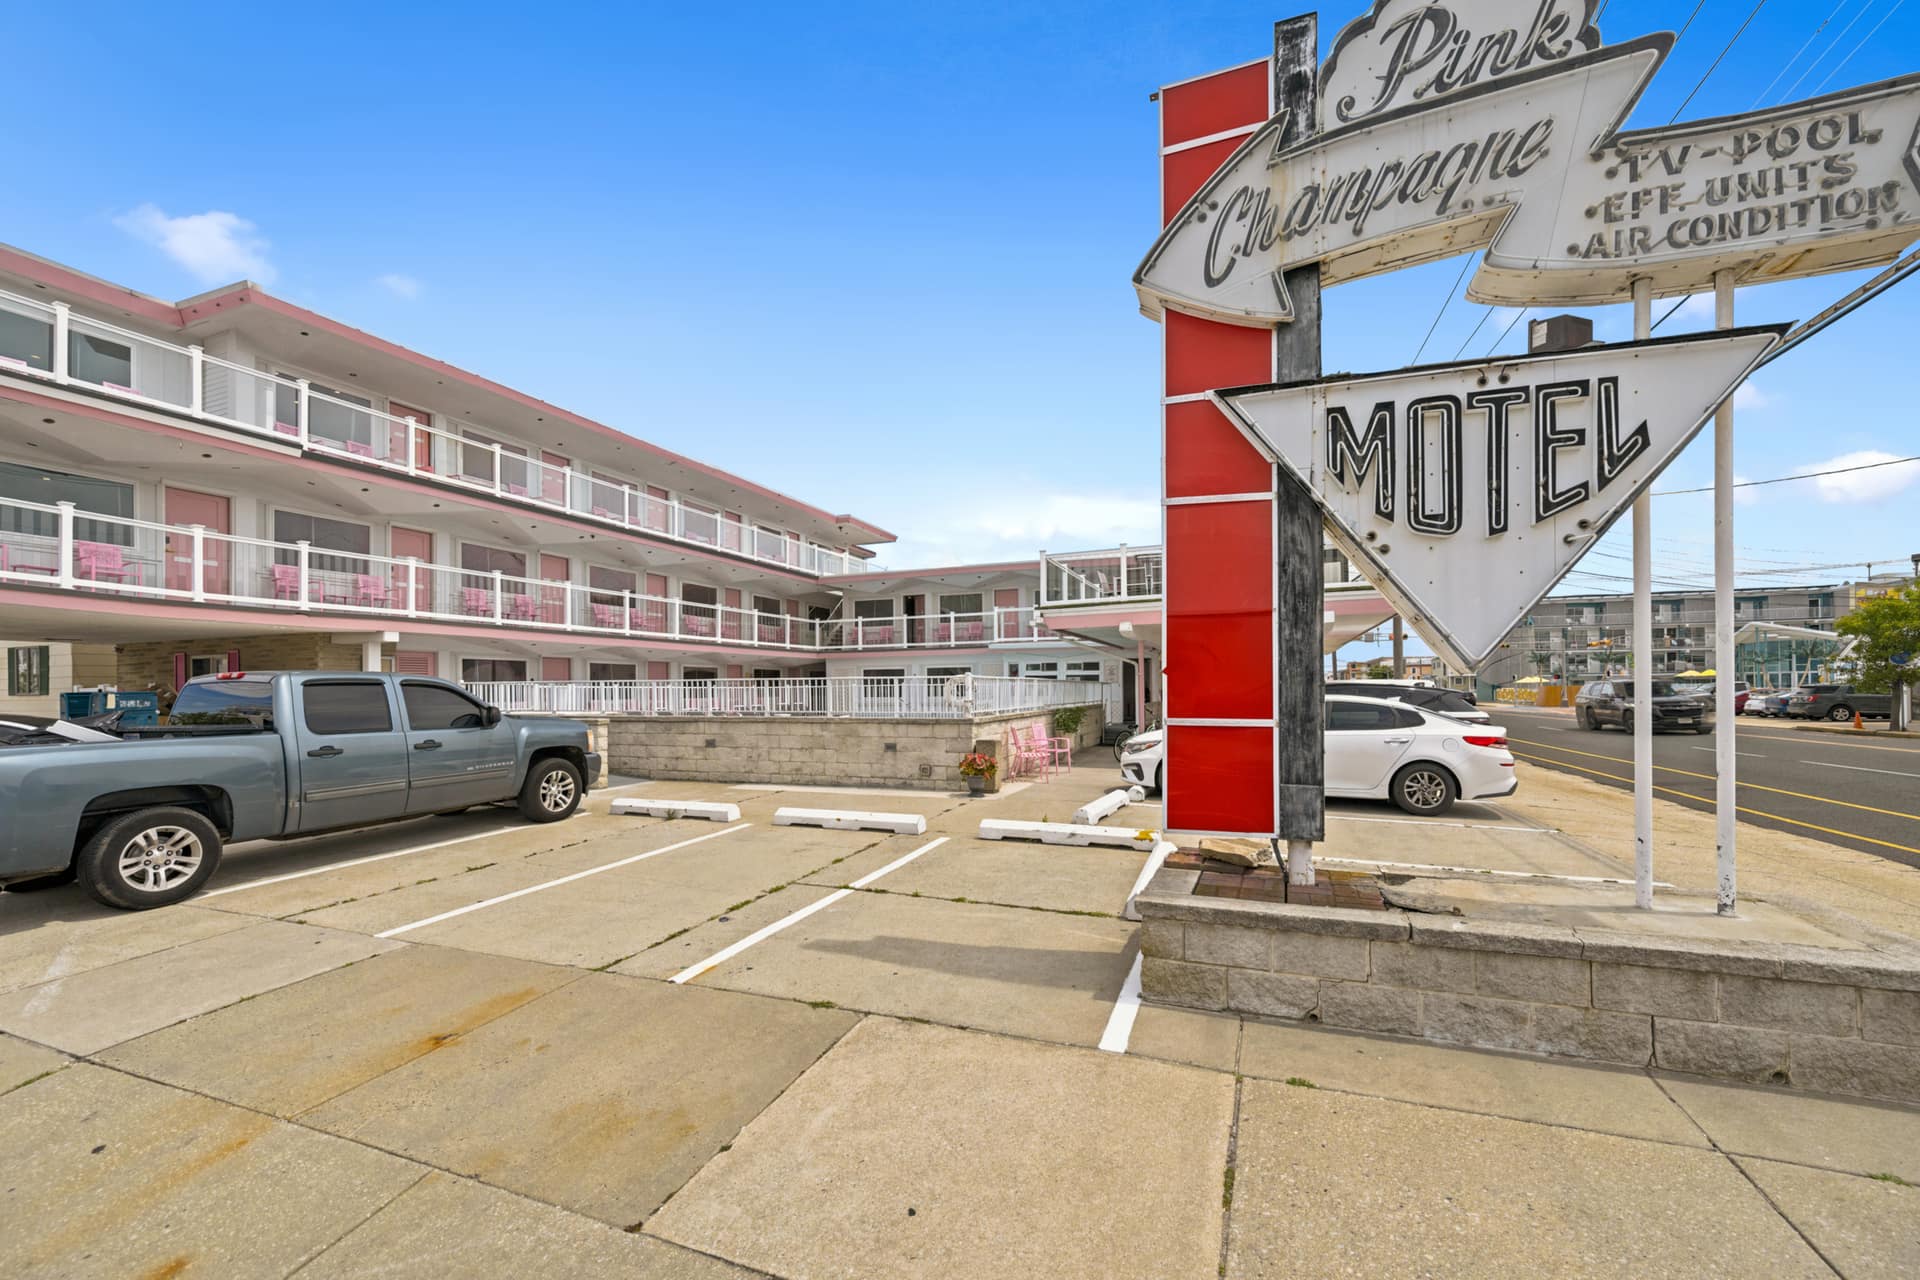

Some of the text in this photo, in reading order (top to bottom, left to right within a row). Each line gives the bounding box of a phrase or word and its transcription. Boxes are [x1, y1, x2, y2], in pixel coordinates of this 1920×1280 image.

[1336, 0, 1572, 123] Pink
[1204, 118, 1554, 288] Champagne
[1582, 180, 1901, 259] AIR CONDITION
[1705, 152, 1857, 207] UNITS
[1326, 375, 1651, 538] MOTEL
